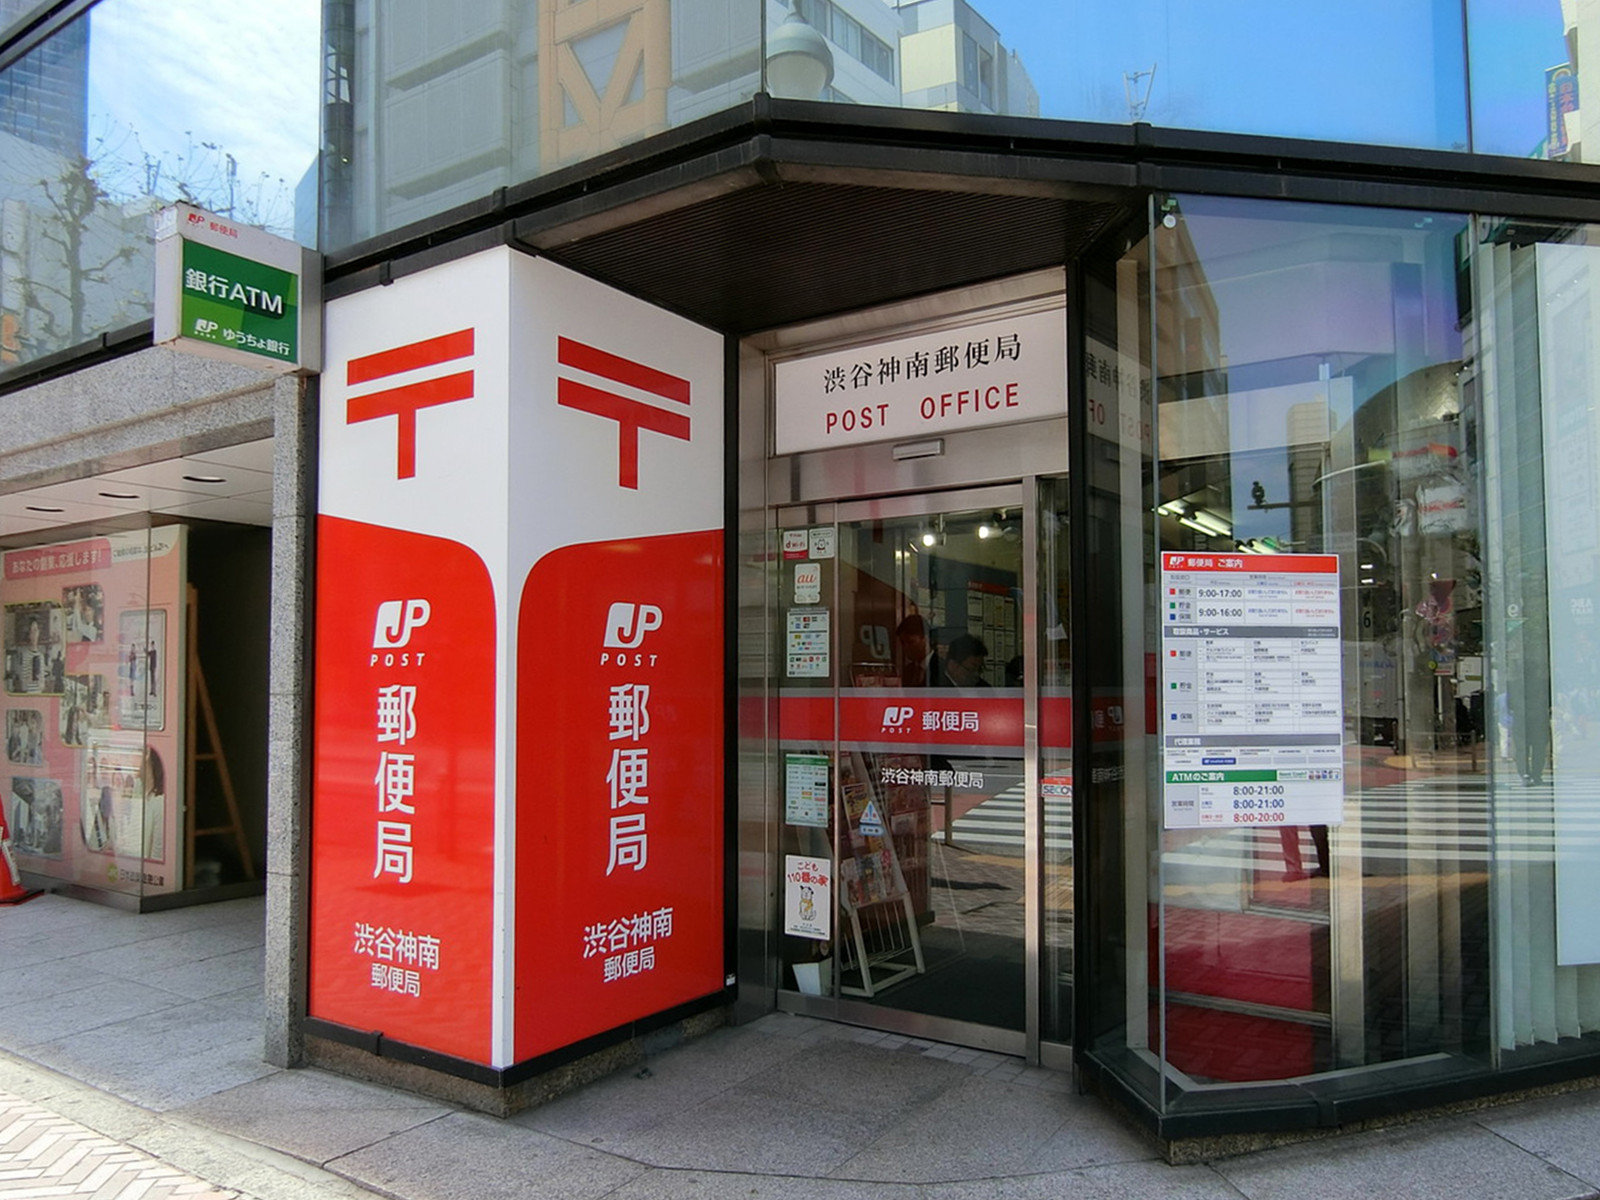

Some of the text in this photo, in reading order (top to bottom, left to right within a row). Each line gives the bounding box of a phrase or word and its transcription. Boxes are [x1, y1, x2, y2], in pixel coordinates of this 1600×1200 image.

[209, 222, 239, 239] 郵便局
[186, 268, 283, 314] 銀行ATM
[223, 328, 290, 356] ゆうちょ銀行
[824, 333, 1022, 394] 渋谷神南郵便局
[826, 382, 1019, 435] POST OFFICE
[1217, 558, 1243, 568] ご案内
[797, 573, 816, 585] au
[1198, 589, 1242, 598] 9:00-17:00
[1198, 608, 1243, 617] 9:00-16:00
[373, 599, 431, 649] JP
[603, 602, 664, 649] JP
[370, 653, 425, 667] POST
[600, 652, 658, 667] POST
[882, 706, 980, 732] JP 郵便局
[373, 684, 417, 884] 郵便局
[606, 684, 650, 877] 郵便局
[881, 767, 984, 789] 渋谷神南郵便局
[1171, 772, 1225, 781] ATMのご案内
[1233, 785, 1285, 796] 8:00-21:00
[1233, 799, 1285, 809] 8:00-21:00
[1233, 812, 1285, 823] 8:00-20:00
[797, 861, 818, 872] こども
[787, 872, 829, 887] 110番の家
[582, 906, 674, 959] 渋谷神南
[354, 922, 440, 970] 渋谷神南
[603, 946, 656, 983] 郵便局
[370, 963, 420, 997] 郵便局
